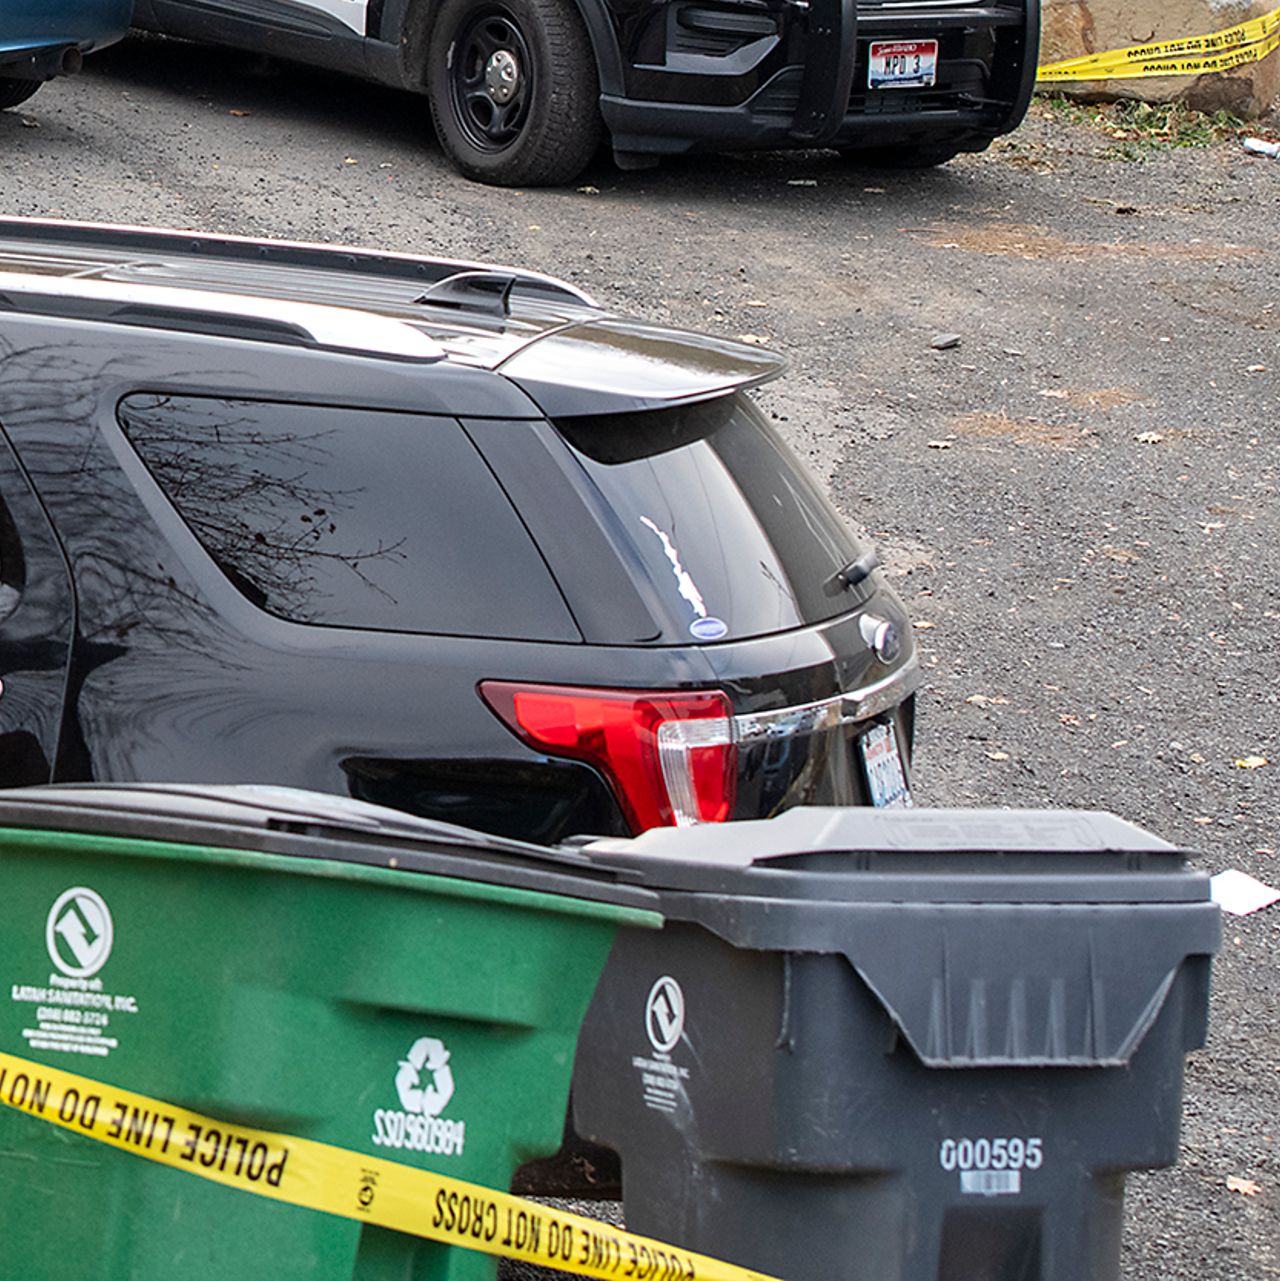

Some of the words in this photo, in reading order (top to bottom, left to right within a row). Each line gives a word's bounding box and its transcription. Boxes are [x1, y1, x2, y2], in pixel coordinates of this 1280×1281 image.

[884, 54, 906, 75] MPD
[912, 54, 921, 74] 3
[57, 1086, 103, 1130] DO
[106, 1100, 176, 1153] LINE
[179, 1121, 289, 1187] POLICE
[428, 1188, 503, 1242] CROSS
[499, 1207, 544, 1253] NOT
[541, 1219, 577, 1261] DO
[577, 1229, 625, 1273] LINE
